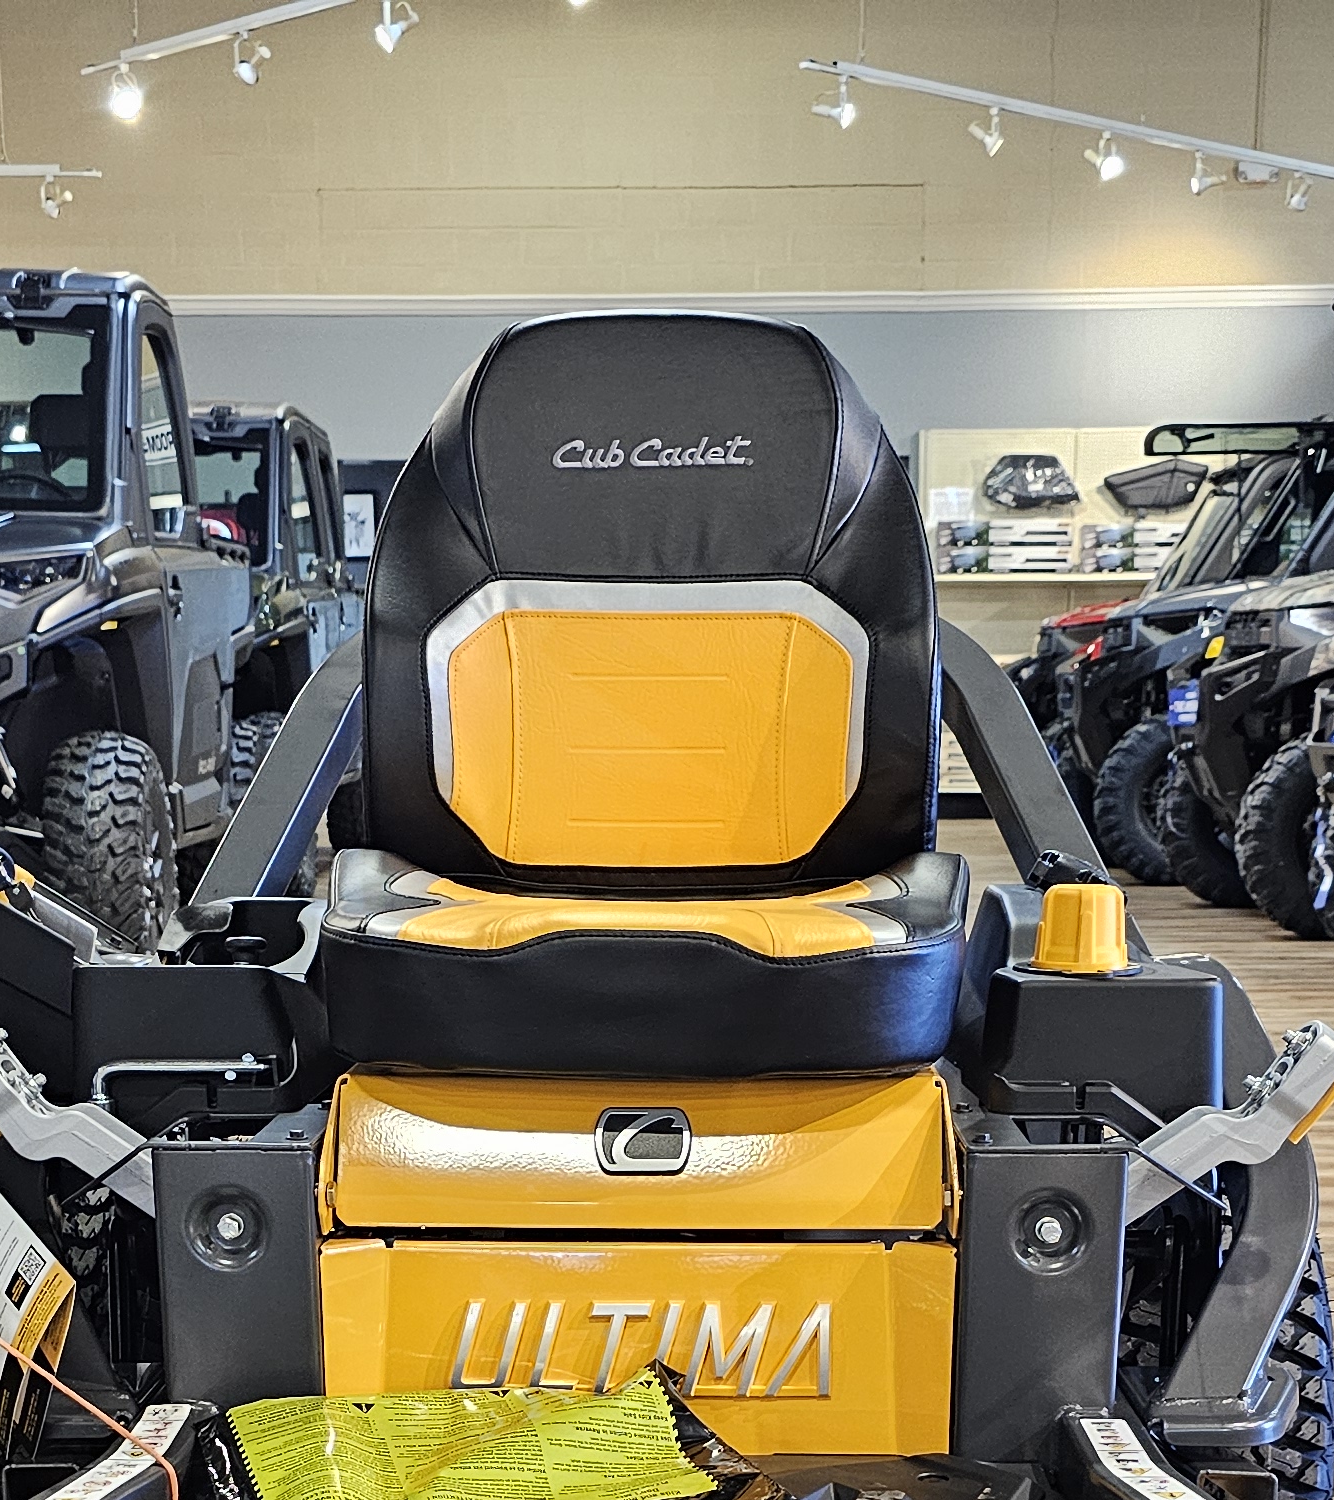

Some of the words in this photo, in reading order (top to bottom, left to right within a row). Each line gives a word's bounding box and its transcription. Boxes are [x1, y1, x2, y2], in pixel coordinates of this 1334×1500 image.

[551, 439, 625, 469] Cub
[629, 435, 753, 468] Cadet
[450, 1299, 832, 1399] ULTIMA
